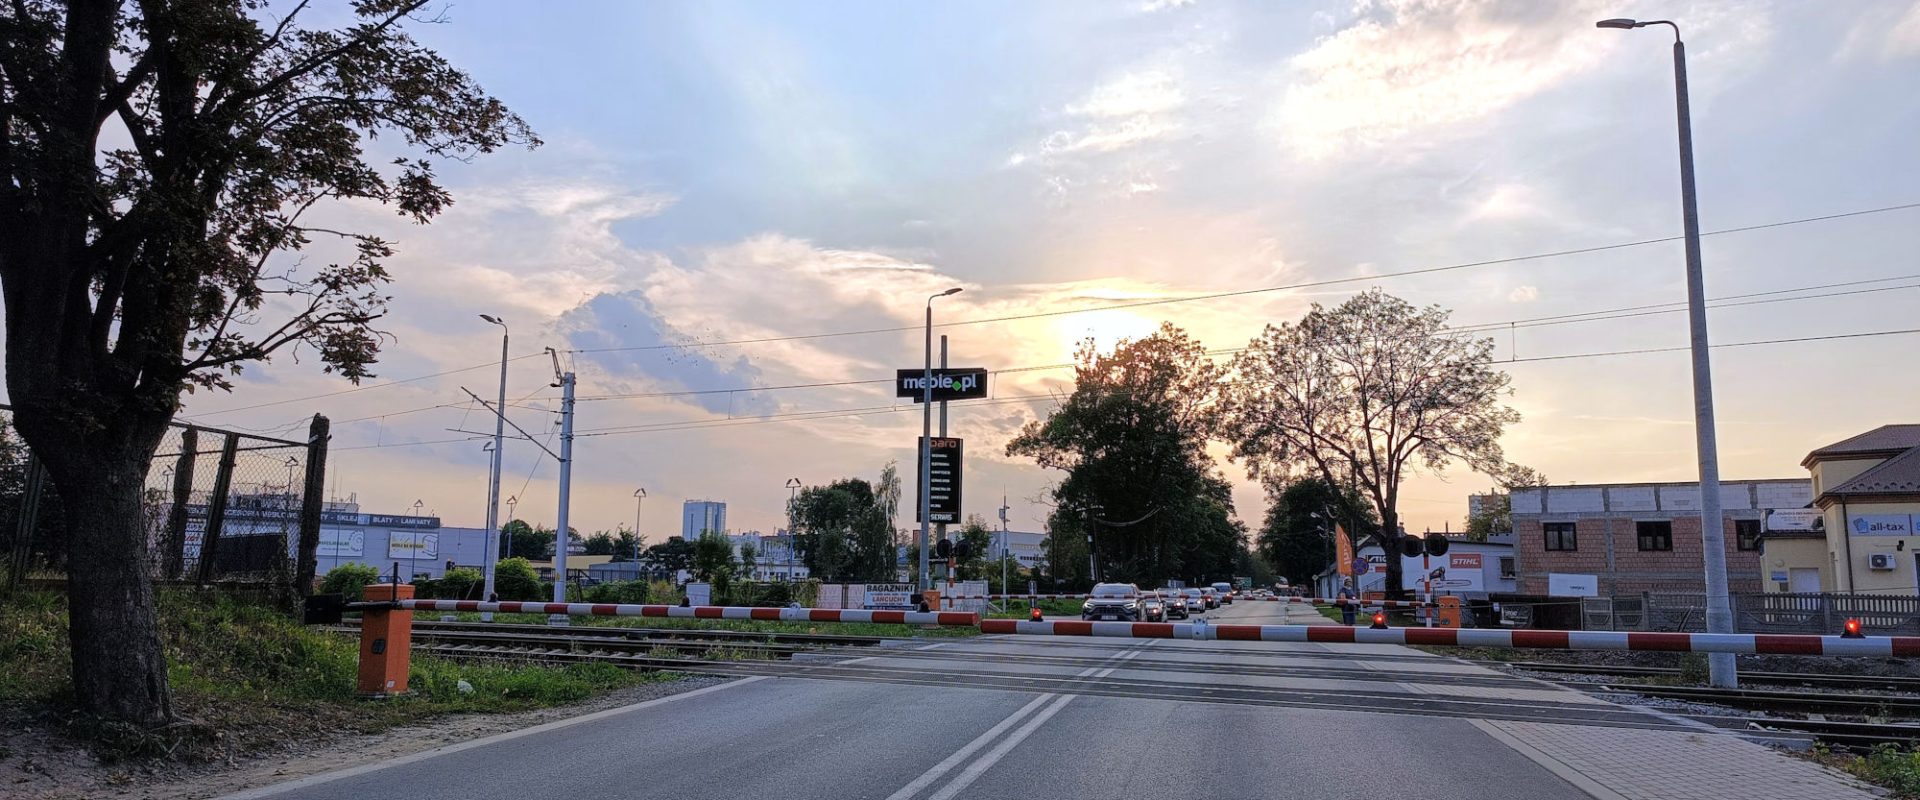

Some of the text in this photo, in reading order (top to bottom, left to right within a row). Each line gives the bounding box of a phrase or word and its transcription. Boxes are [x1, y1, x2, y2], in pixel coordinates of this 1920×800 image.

[372, 516, 393, 525] BLATY
[930, 513, 953, 521] SERWIS
[1870, 522, 1905, 531] all-tax
